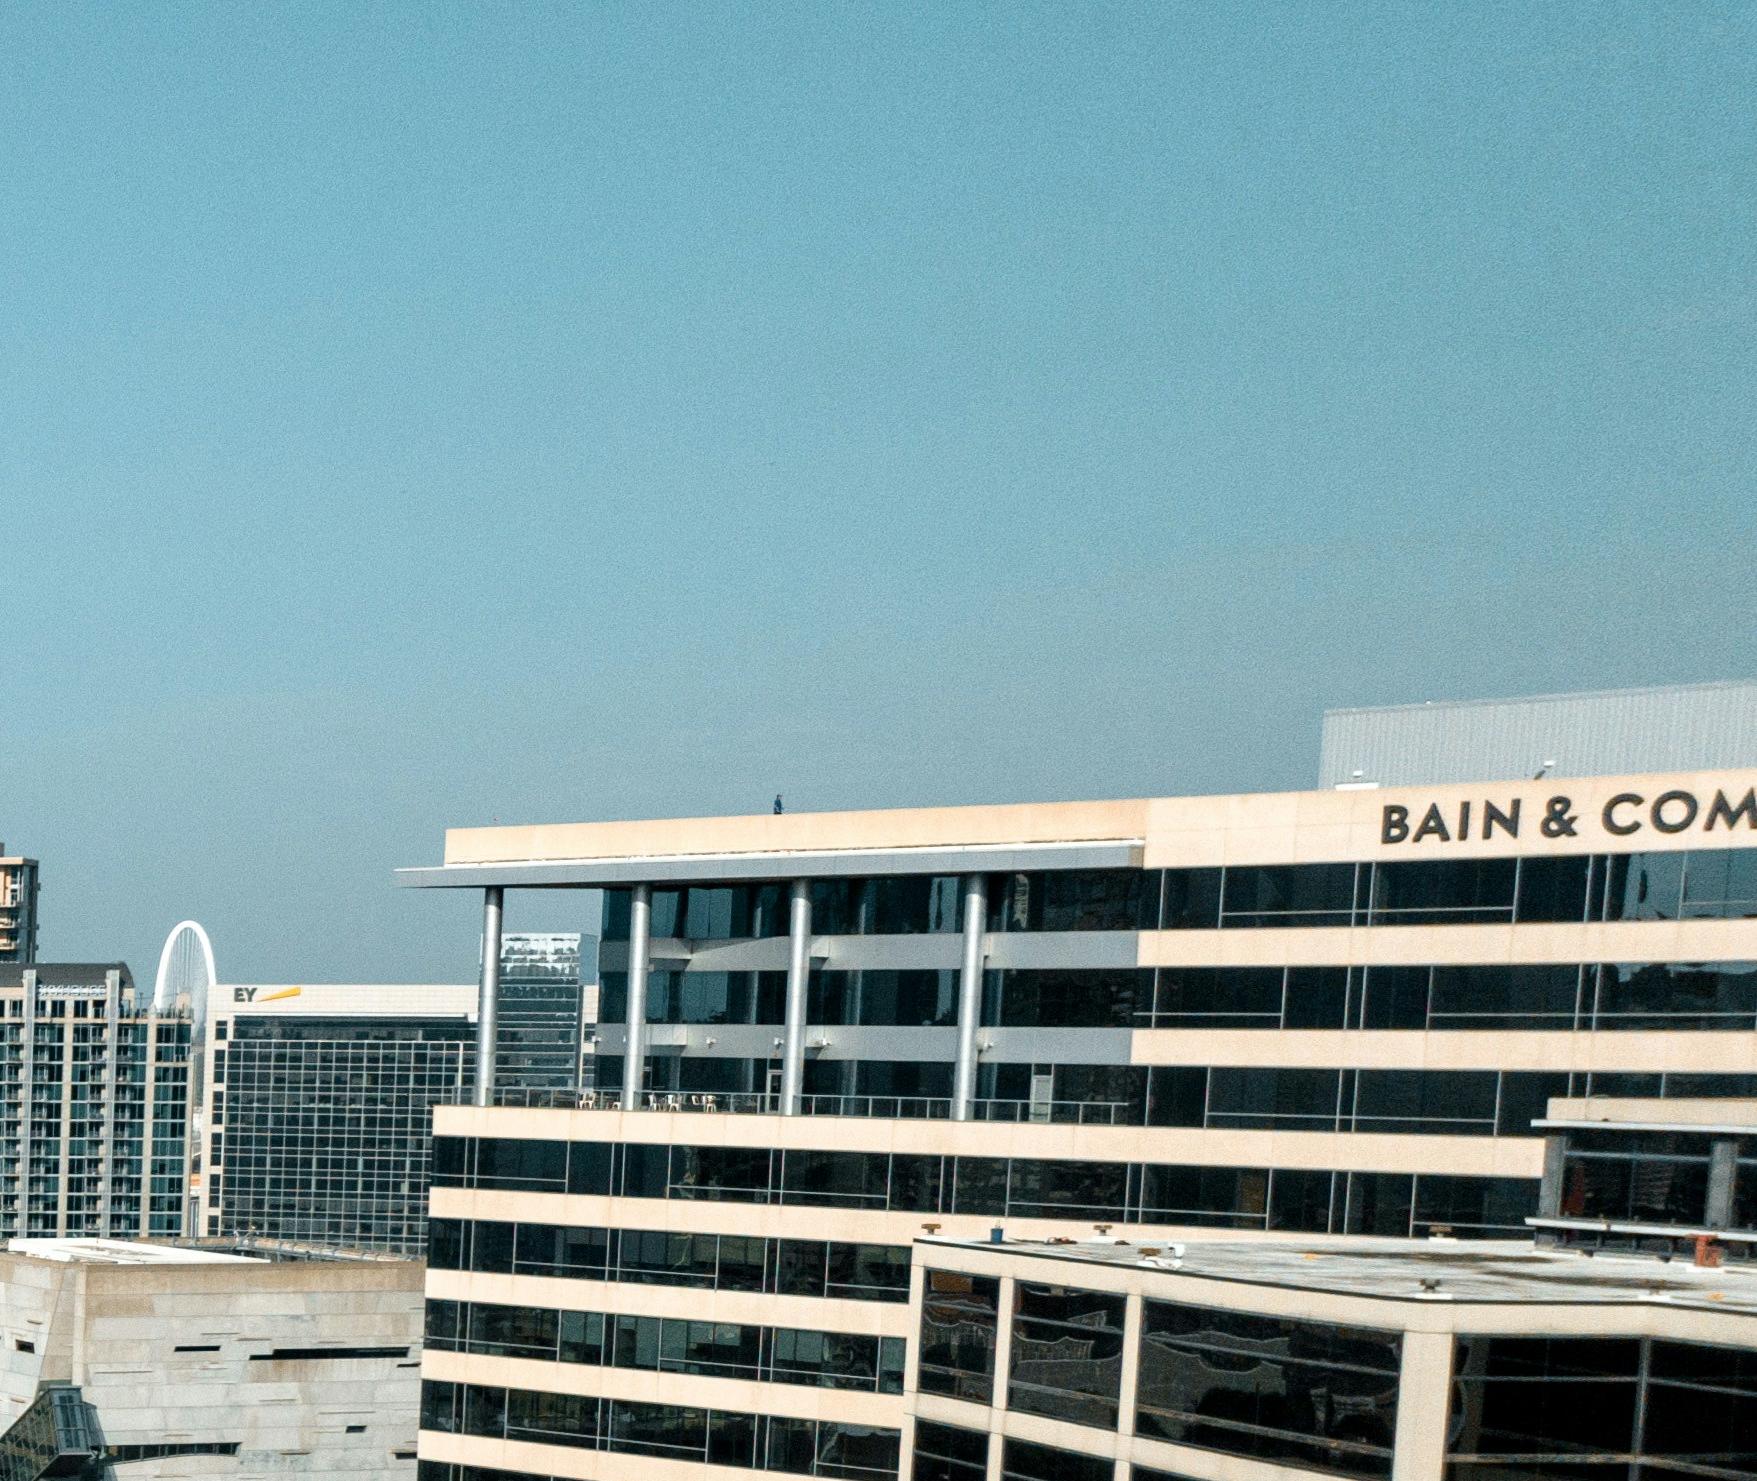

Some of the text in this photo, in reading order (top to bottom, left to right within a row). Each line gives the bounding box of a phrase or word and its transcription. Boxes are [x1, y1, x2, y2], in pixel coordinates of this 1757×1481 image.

[1381, 787, 1757, 845] BAIN & COM
[233, 987, 258, 1003] EY
